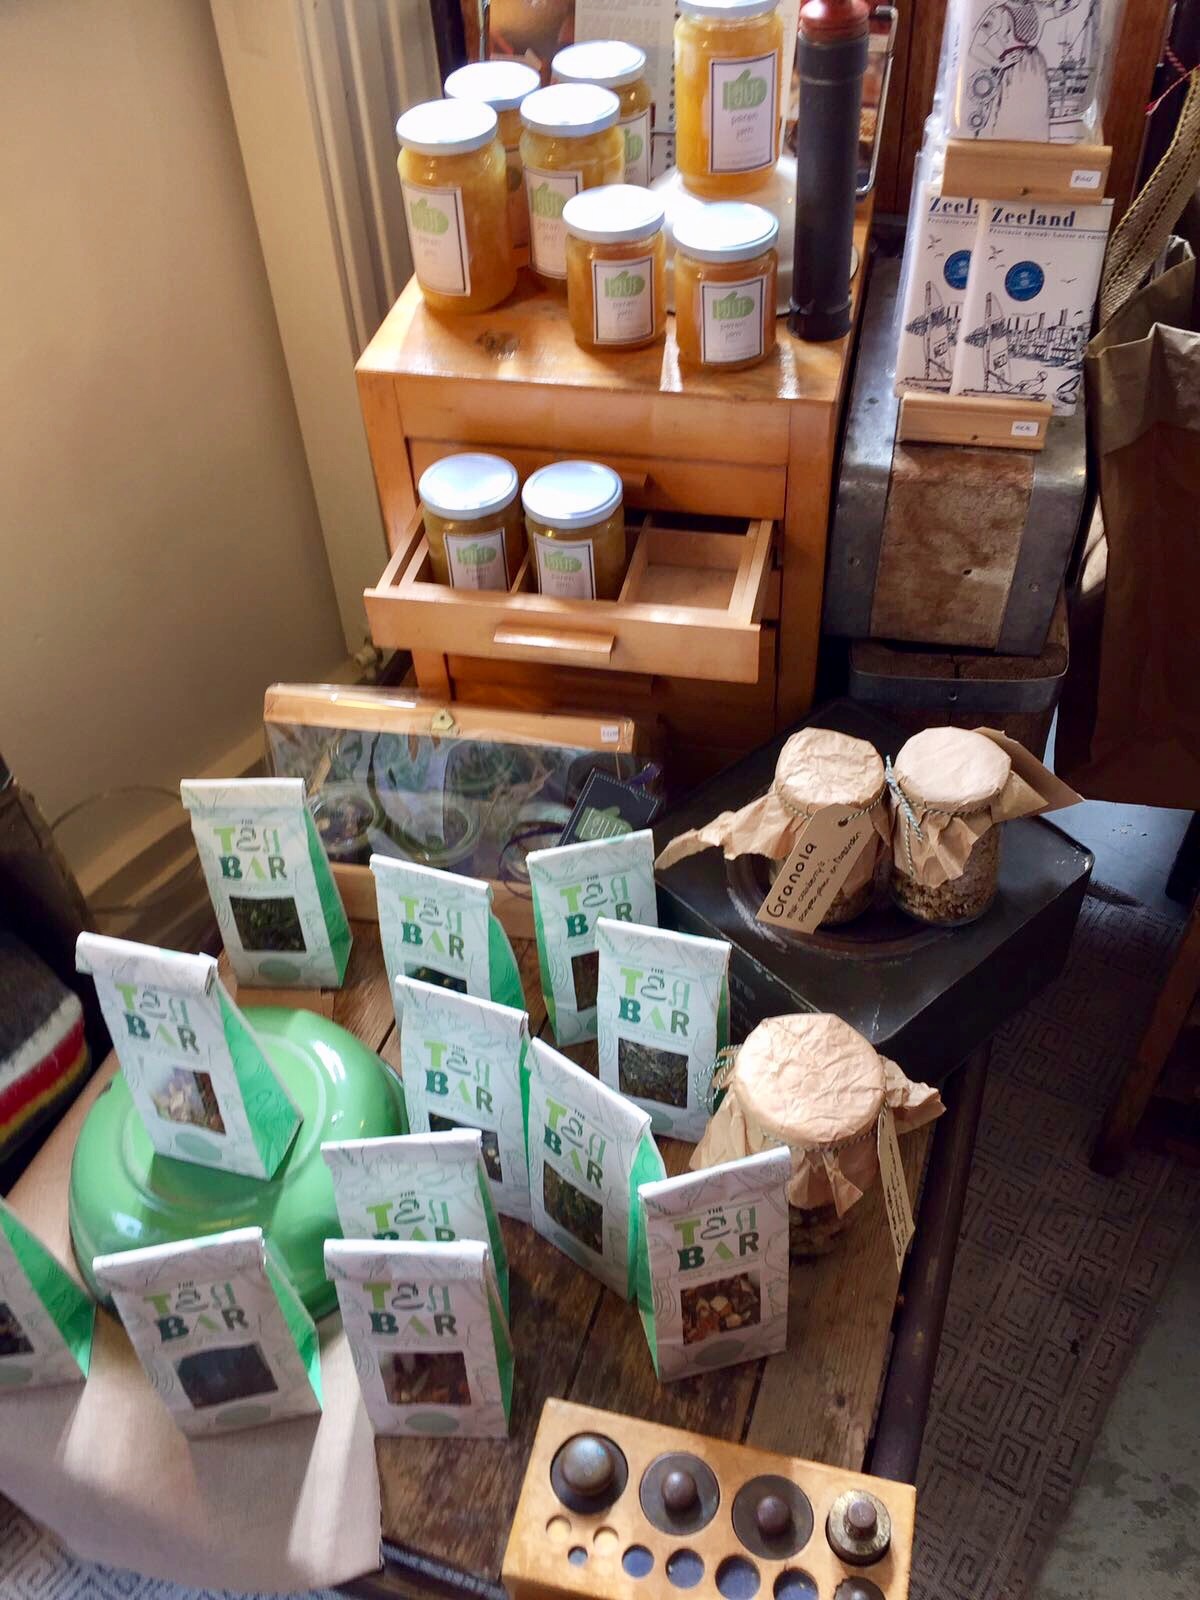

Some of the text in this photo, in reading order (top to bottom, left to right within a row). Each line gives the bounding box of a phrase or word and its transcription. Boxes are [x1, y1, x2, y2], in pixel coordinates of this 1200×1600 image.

[991, 207, 1076, 228] Zeeland
[219, 855, 287, 880] BAR
[766, 841, 818, 918] Granola
[401, 921, 465, 960] BAR
[122, 1011, 201, 1055] BAR
[618, 996, 690, 1037] BAR
[425, 1069, 494, 1113] BAR
[543, 1124, 604, 1190] BAR
[677, 1232, 760, 1272] BAR
[154, 1308, 250, 1343] BAR
[368, 1311, 458, 1337] BAR
